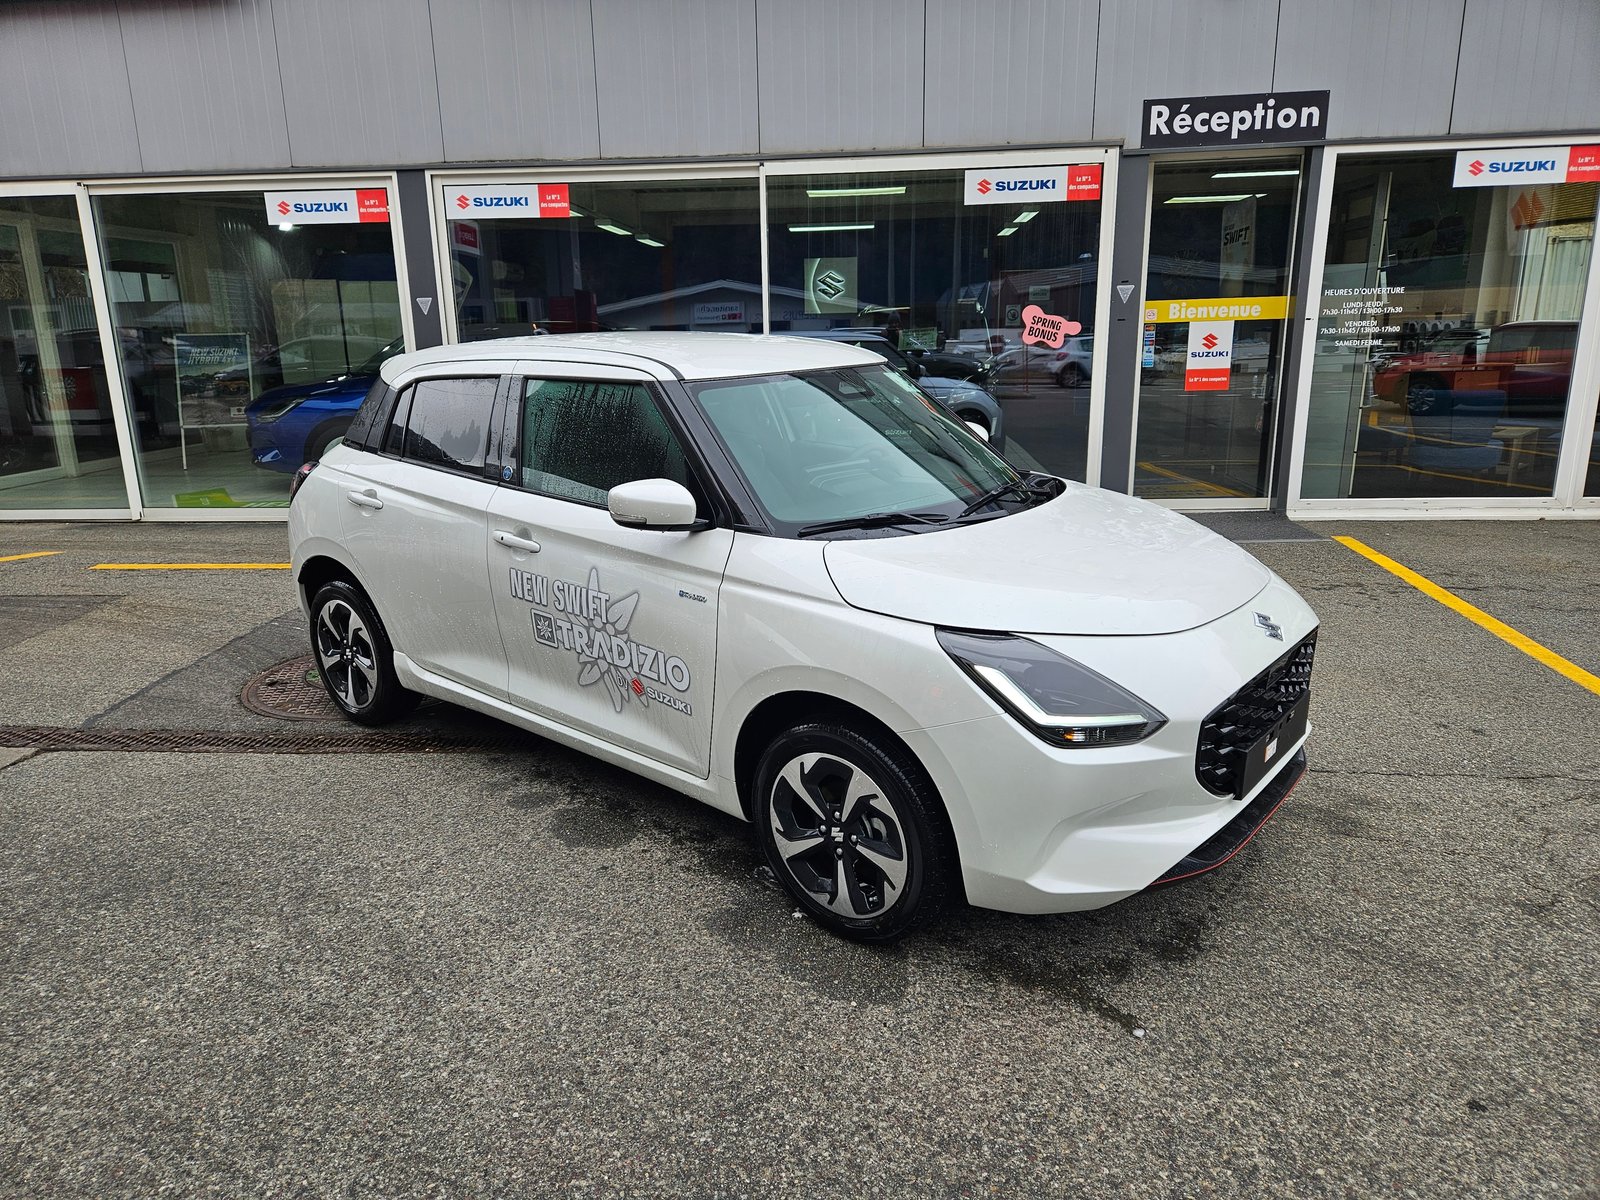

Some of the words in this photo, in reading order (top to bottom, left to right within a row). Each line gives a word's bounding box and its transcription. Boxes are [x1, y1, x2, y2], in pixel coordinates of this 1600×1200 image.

[1149, 98, 1320, 140] Réception
[1488, 160, 1556, 173] SUZUKI
[995, 179, 1056, 192] SUZUKI
[293, 202, 348, 213] SUZUKI
[473, 196, 529, 207] SUZUKI
[1223, 226, 1250, 246] SWIFT
[1324, 288, 1353, 296] HEURES
[1354, 286, 1405, 295] D'OUVERTURE
[1169, 302, 1262, 319] Bienvenue
[1363, 306, 1403, 314] 13h00-17h30
[1031, 315, 1062, 331] SPRING
[1361, 325, 1400, 333] 13h00-17h00
[1028, 326, 1058, 342] BONUS
[190, 348, 209, 356] NEW
[1191, 350, 1229, 358] SUZUKI
[188, 356, 220, 365] HYBRID
[509, 567, 549, 607] NEW
[553, 580, 610, 623] SWIFT
[556, 618, 691, 692] TRADIZIO
[616, 669, 628, 690] by
[646, 687, 692, 716] SUZUKI
